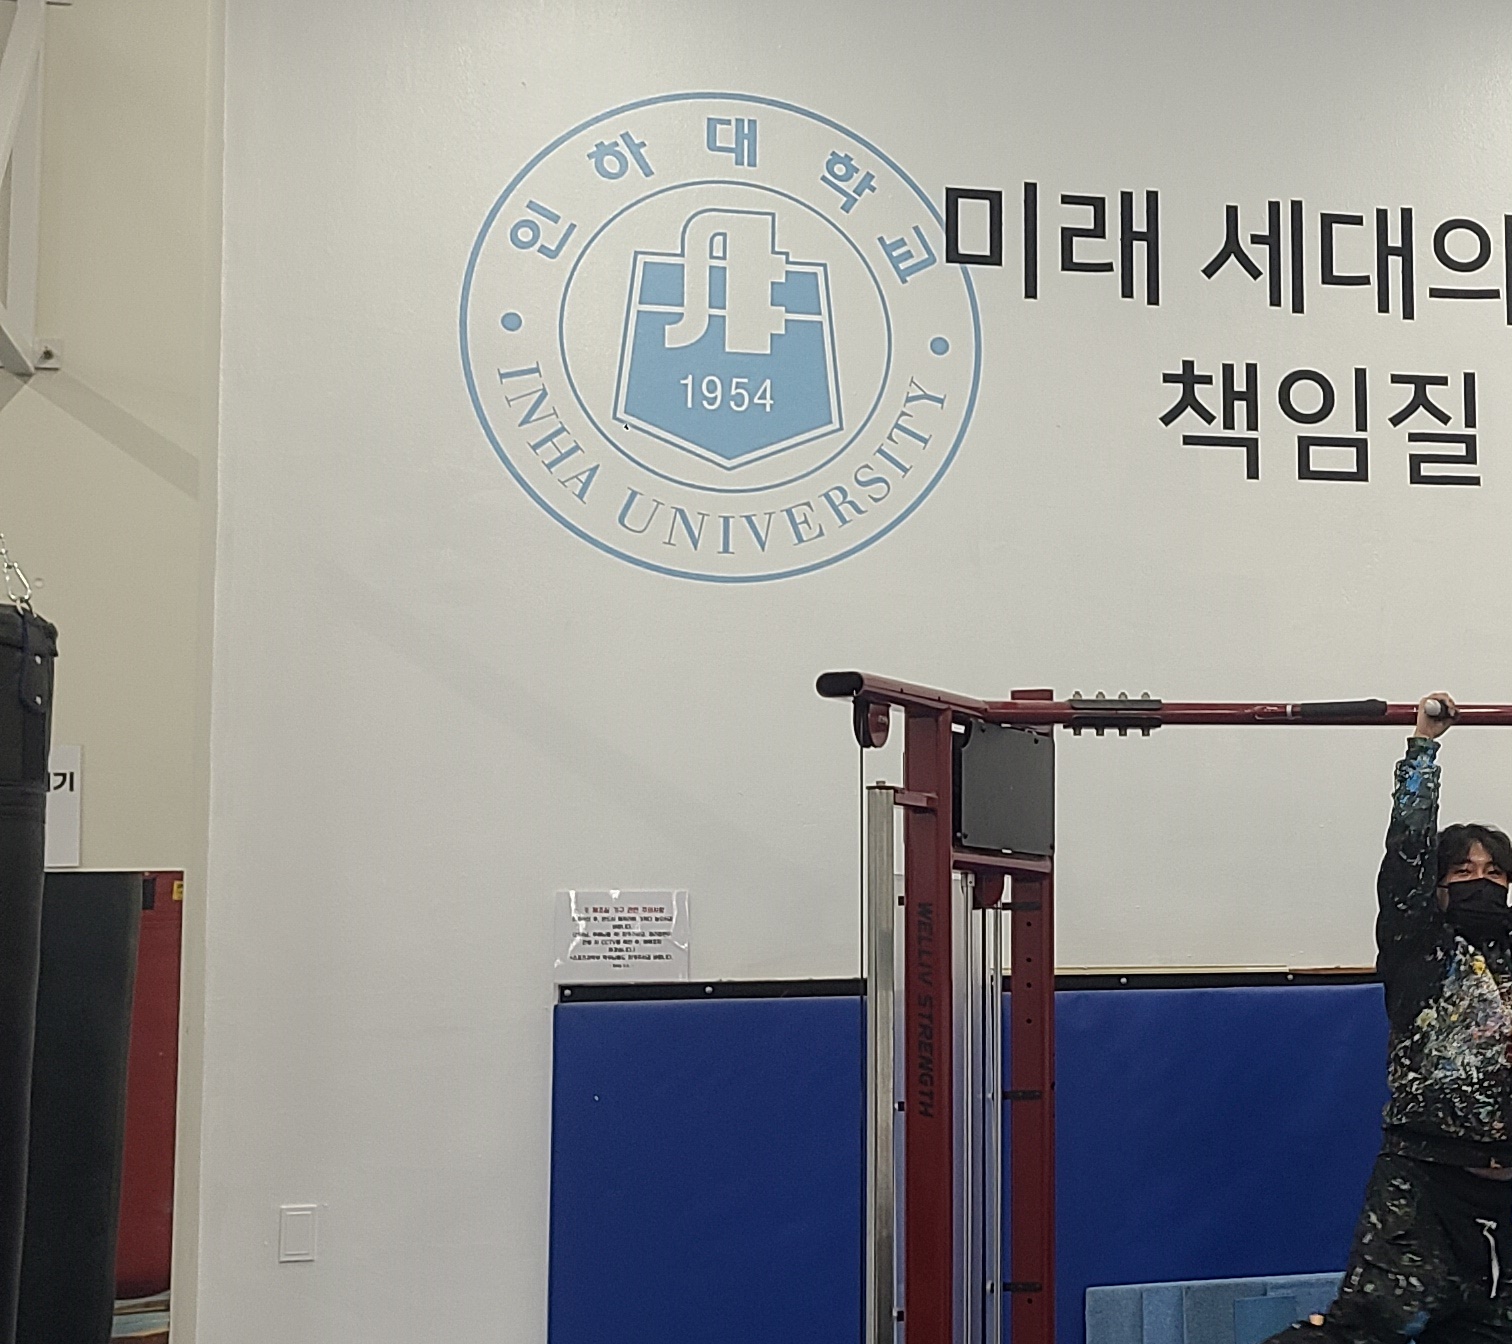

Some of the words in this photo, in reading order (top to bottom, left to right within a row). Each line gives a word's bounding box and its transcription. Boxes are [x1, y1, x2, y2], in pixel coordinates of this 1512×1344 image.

[509, 116, 940, 285] 인하대학교
[945, 181, 1160, 306] 미래
[679, 373, 776, 413] 1954
[1159, 359, 1482, 487] 책임질
[497, 360, 591, 505] INHA
[616, 376, 948, 557] UNIVERSITY
[47, 771, 75, 792] 기
[917, 993, 935, 1119] STRENGTH
